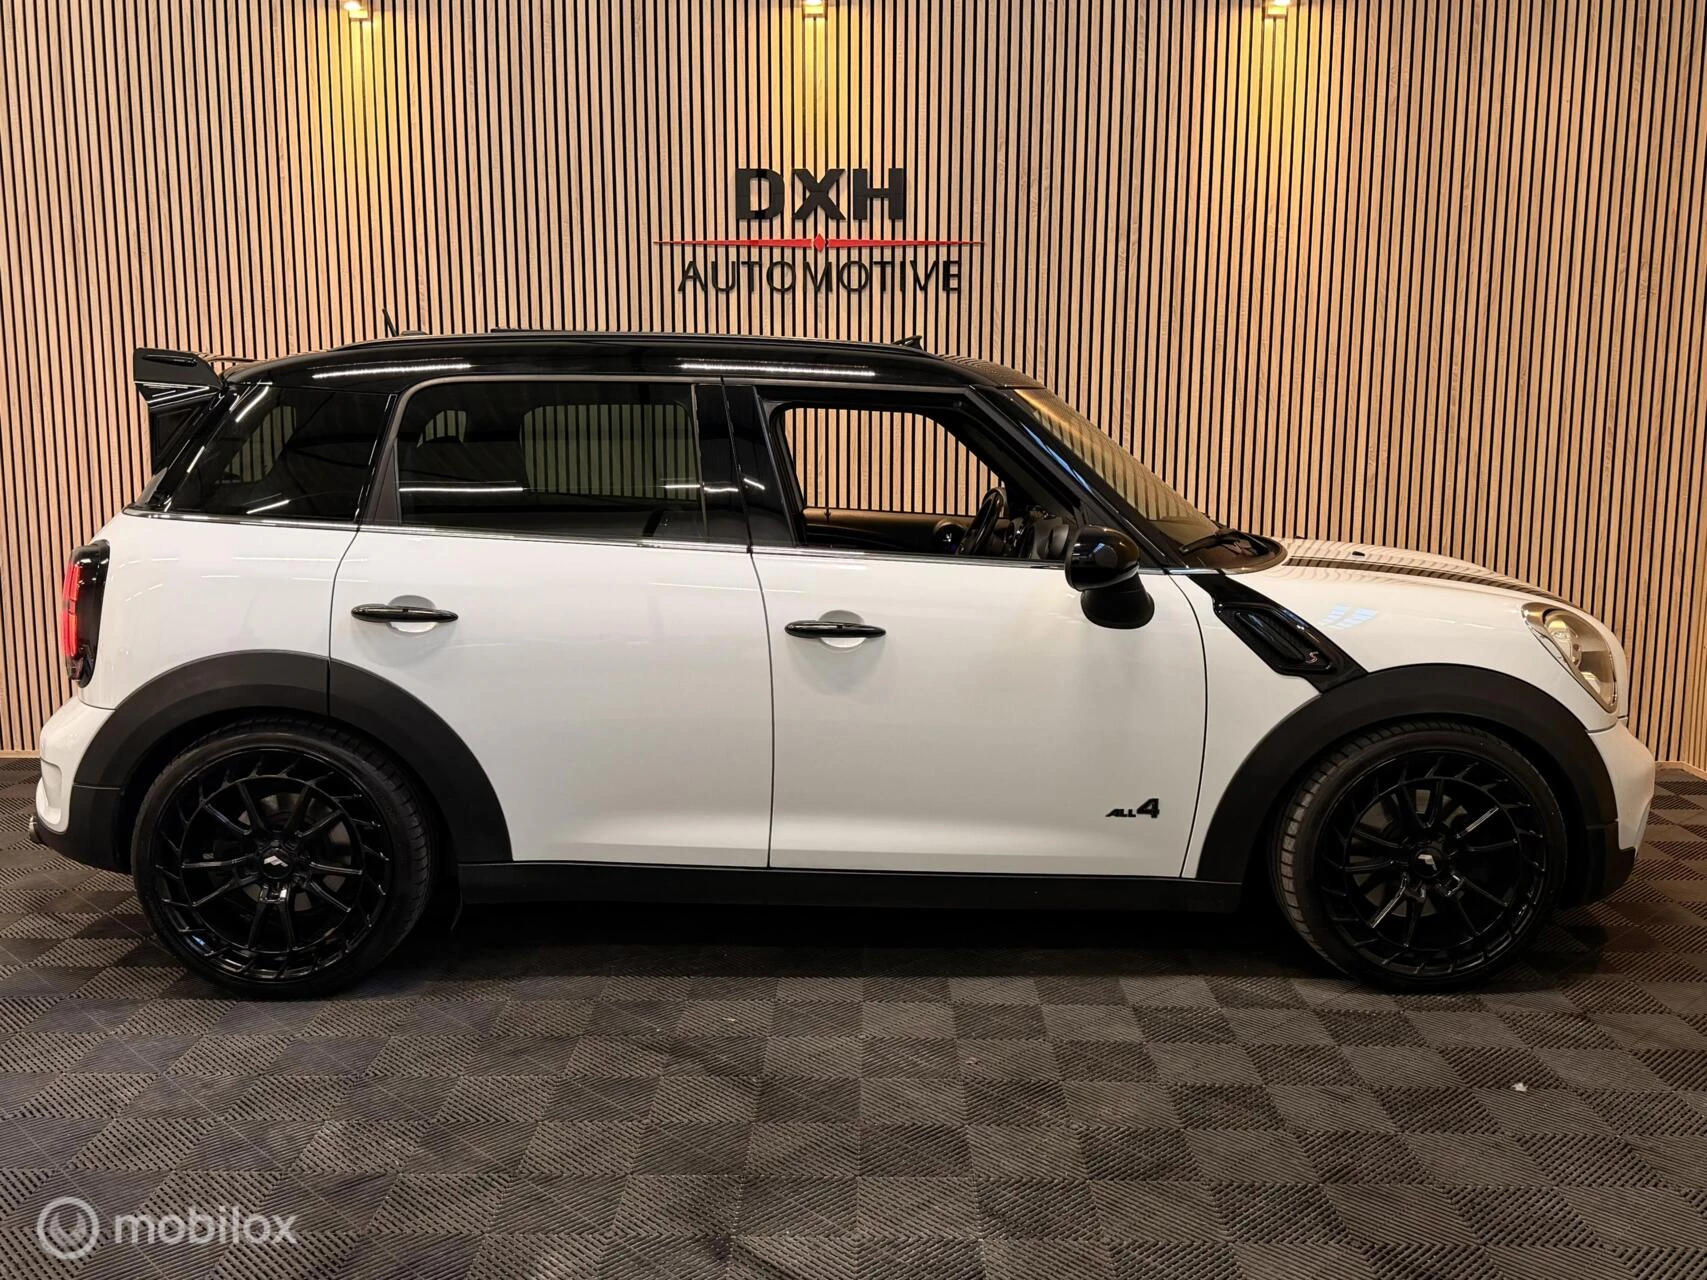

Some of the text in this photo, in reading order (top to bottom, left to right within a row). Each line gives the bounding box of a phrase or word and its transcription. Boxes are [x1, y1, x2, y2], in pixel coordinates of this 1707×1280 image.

[735, 168, 906, 220] DXH
[678, 260, 961, 293] AUTOMOTIVE
[1305, 651, 1319, 664] S
